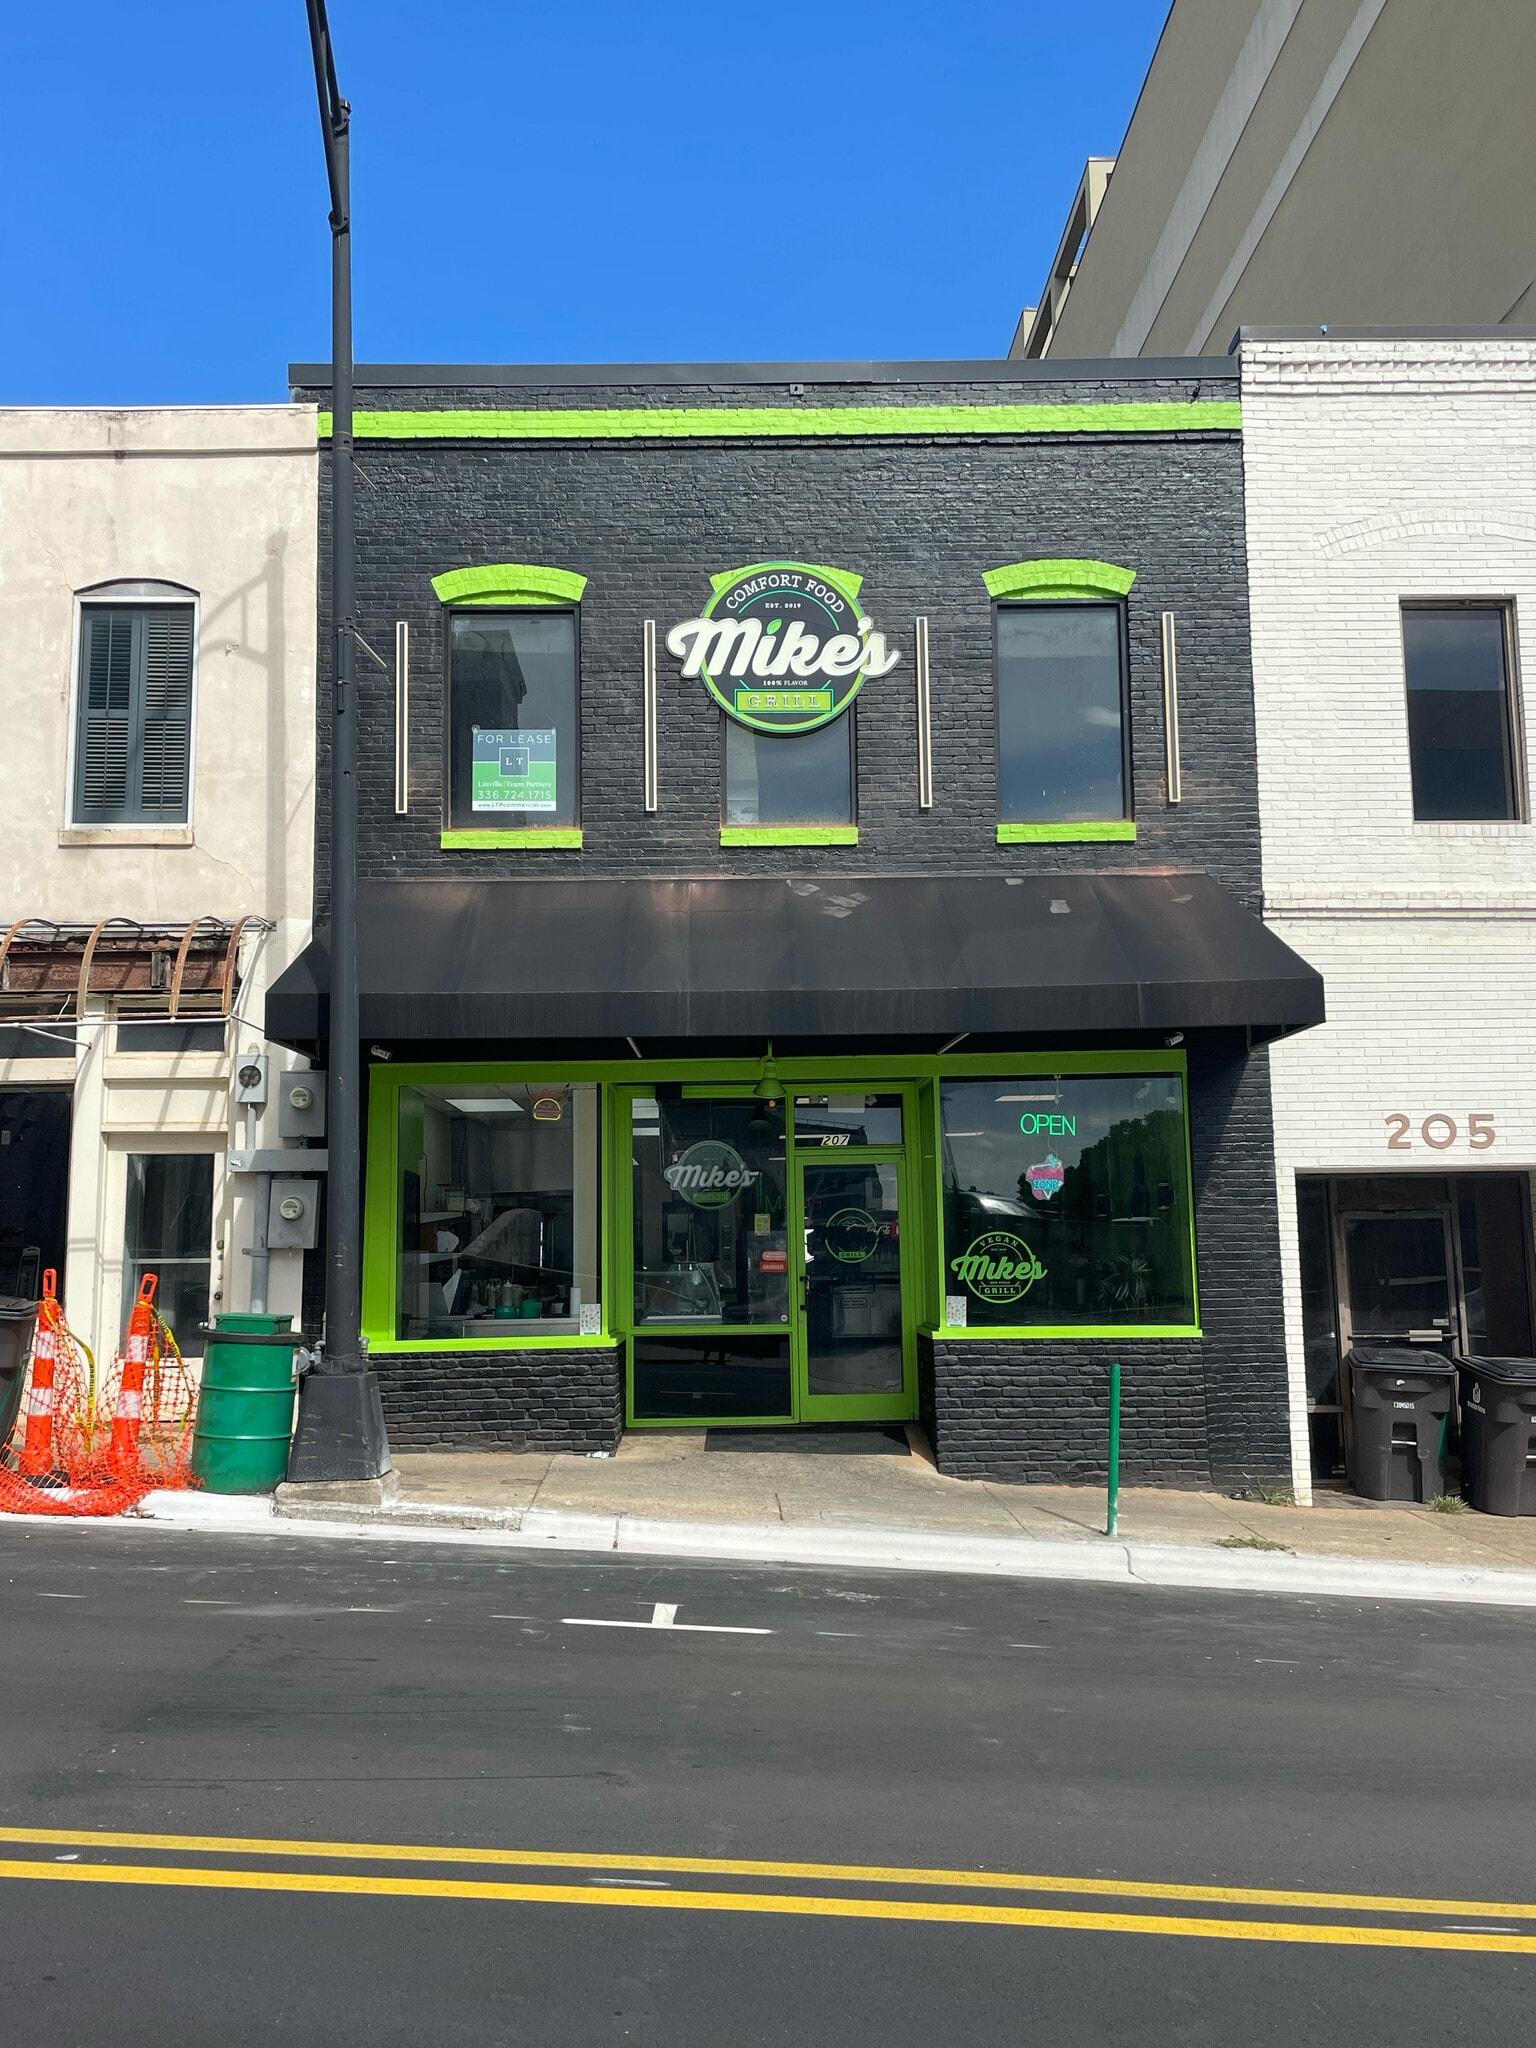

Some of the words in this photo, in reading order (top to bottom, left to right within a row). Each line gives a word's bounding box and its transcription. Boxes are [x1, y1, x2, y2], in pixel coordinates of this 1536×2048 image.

[726, 574, 802, 609] COMFORT
[804, 579, 845, 613] FOOD
[667, 616, 901, 677] Mike's
[748, 694, 821, 709] GRILL
[477, 734, 504, 744] FOR
[510, 734, 552, 744] LEASE
[506, 780, 524, 788] Team
[525, 780, 551, 788] Partners
[478, 790, 552, 800] 336.724.1715
[1020, 1113, 1077, 1136] OPEN
[1384, 1113, 1496, 1149] 205
[823, 1135, 848, 1146] 207
[666, 1164, 756, 1188] Mike's
[1034, 1179, 1058, 1190] ZONE
[980, 1236, 1019, 1247] VEGAN
[951, 1254, 1048, 1280] Mike's
